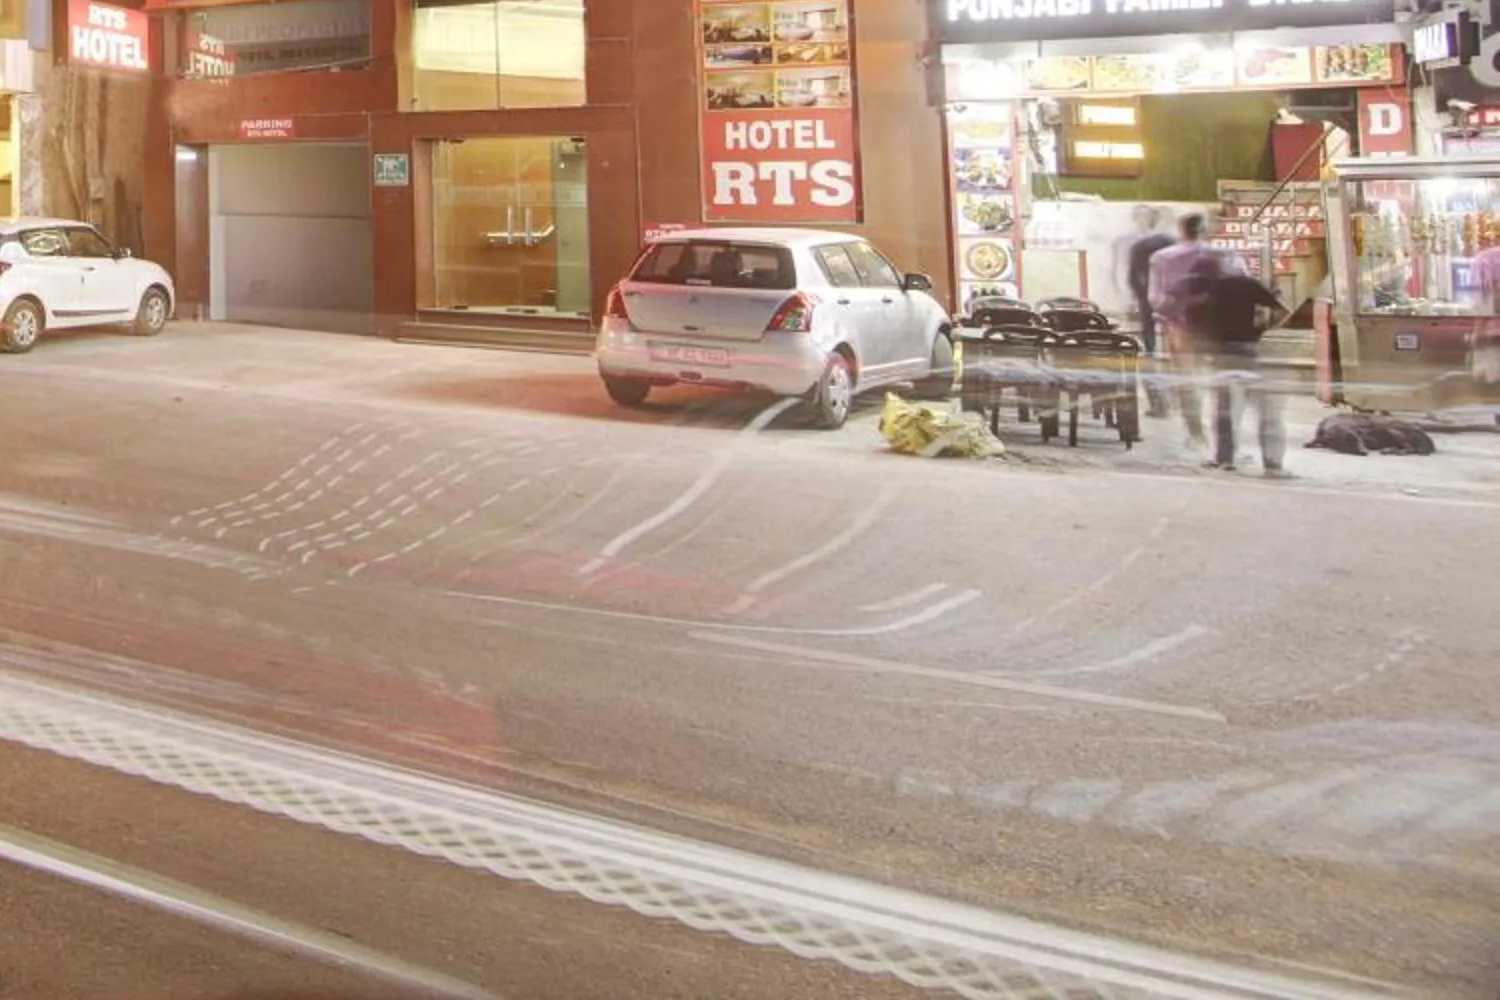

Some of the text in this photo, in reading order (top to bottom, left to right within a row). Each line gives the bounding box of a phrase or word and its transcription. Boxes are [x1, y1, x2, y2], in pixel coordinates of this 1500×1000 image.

[88, 3, 128, 31] RTS
[72, 26, 148, 69] HOTEL
[241, 119, 293, 129] PARKING
[725, 119, 836, 150] HOTEL
[712, 160, 855, 207] RTS
